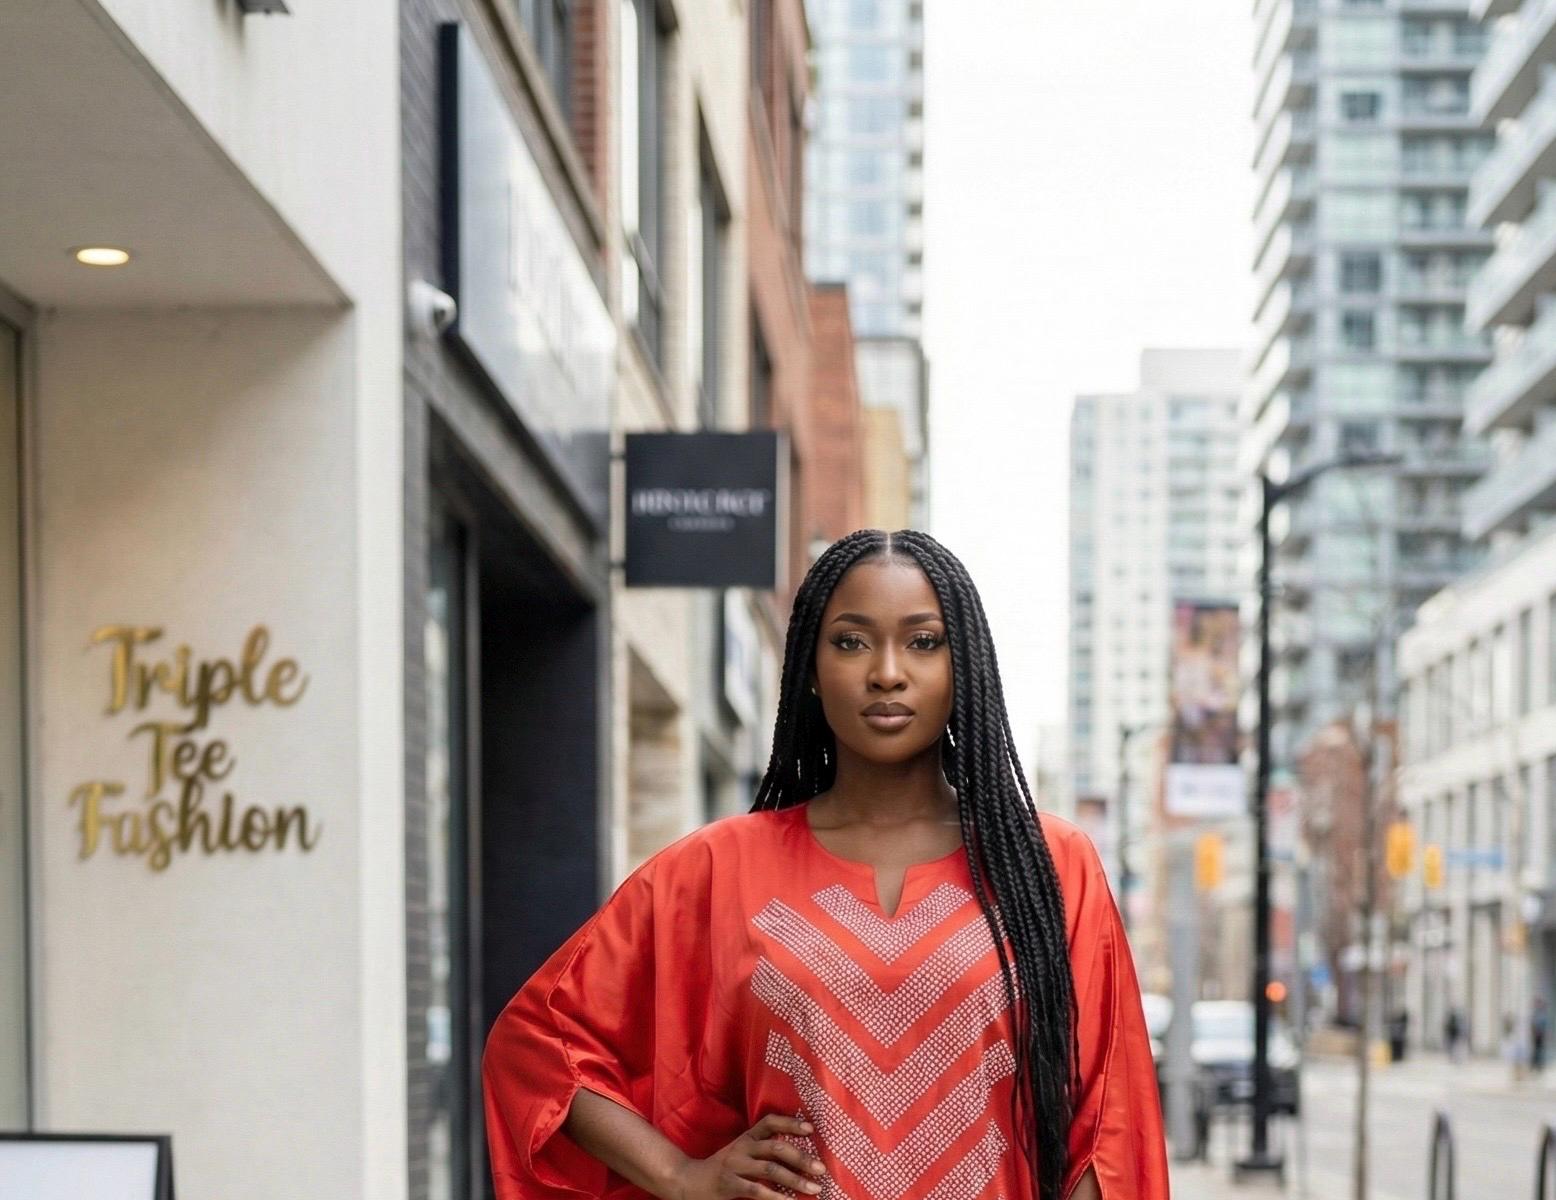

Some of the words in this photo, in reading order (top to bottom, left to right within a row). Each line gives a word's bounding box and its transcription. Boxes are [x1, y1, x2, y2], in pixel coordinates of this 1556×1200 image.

[86, 624, 309, 731] Triple
[128, 721, 235, 799] Tee
[67, 775, 322, 872] Fashion
